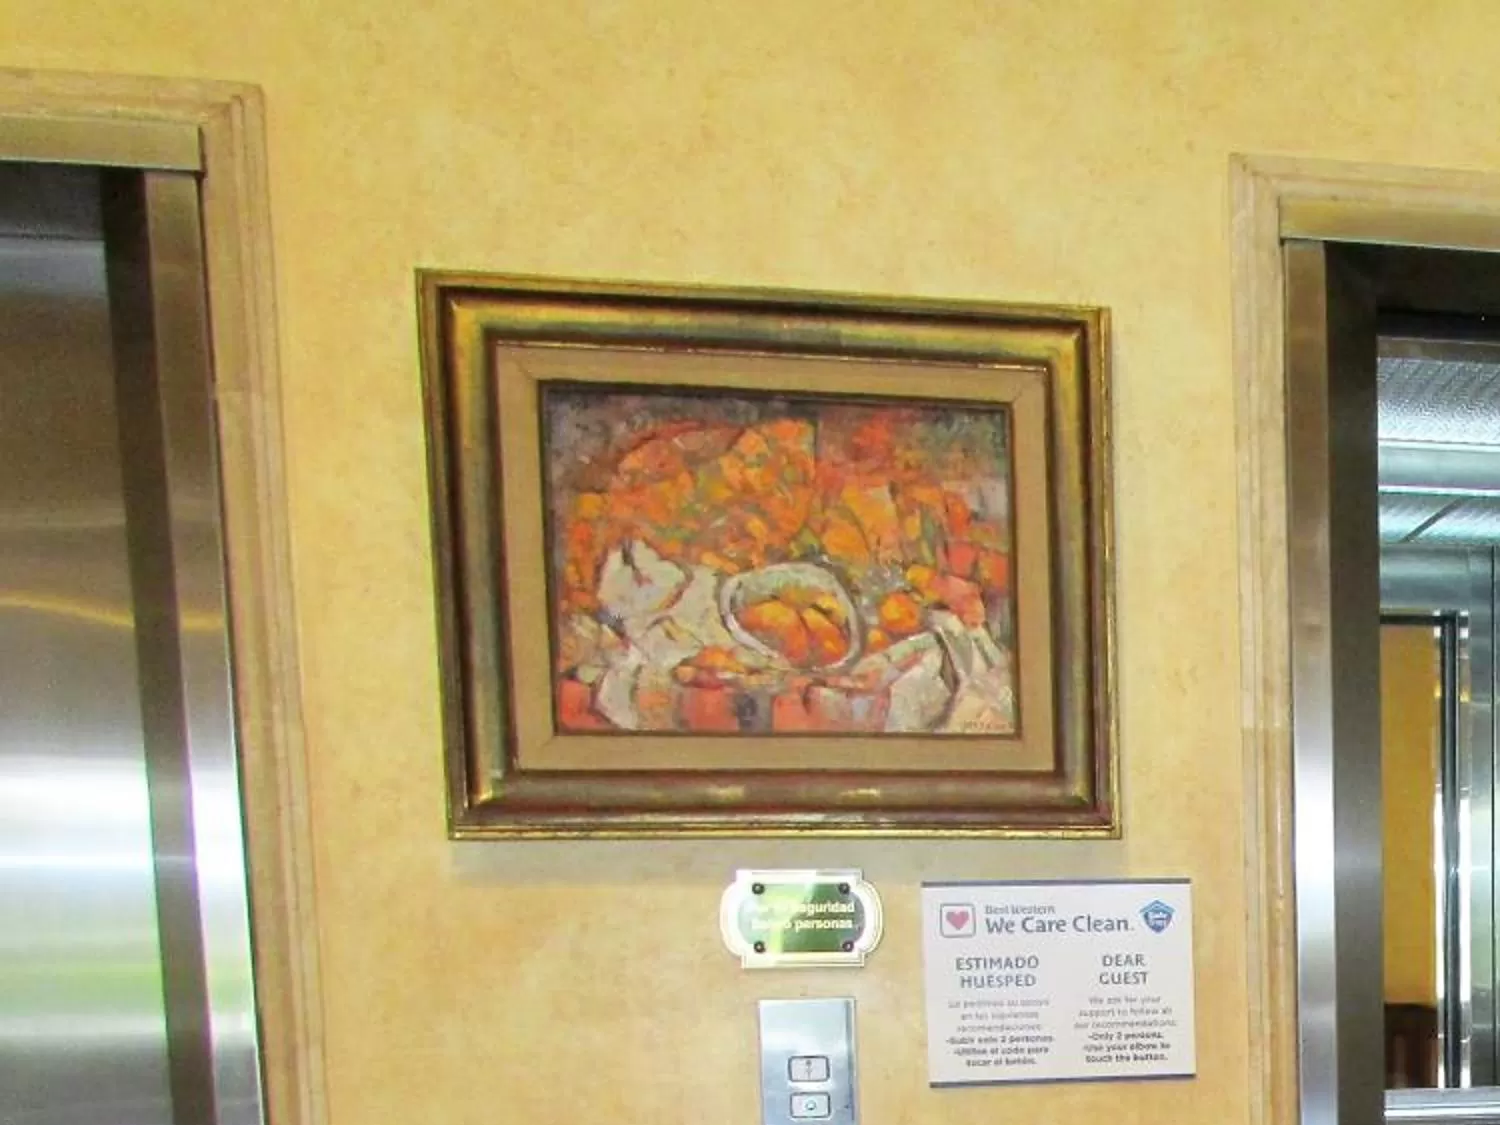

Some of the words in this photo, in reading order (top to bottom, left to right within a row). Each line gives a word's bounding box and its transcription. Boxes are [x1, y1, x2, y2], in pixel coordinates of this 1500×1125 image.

[984, 904, 1009, 915] Best
[1009, 904, 1056, 915] Western
[795, 918, 853, 933] personas
[985, 918, 1015, 934] We
[1021, 916, 1067, 933] Care
[955, 955, 1039, 971] ESTIMADO
[1103, 953, 1146, 967] DEAR
[1099, 971, 1149, 985] GUEST
